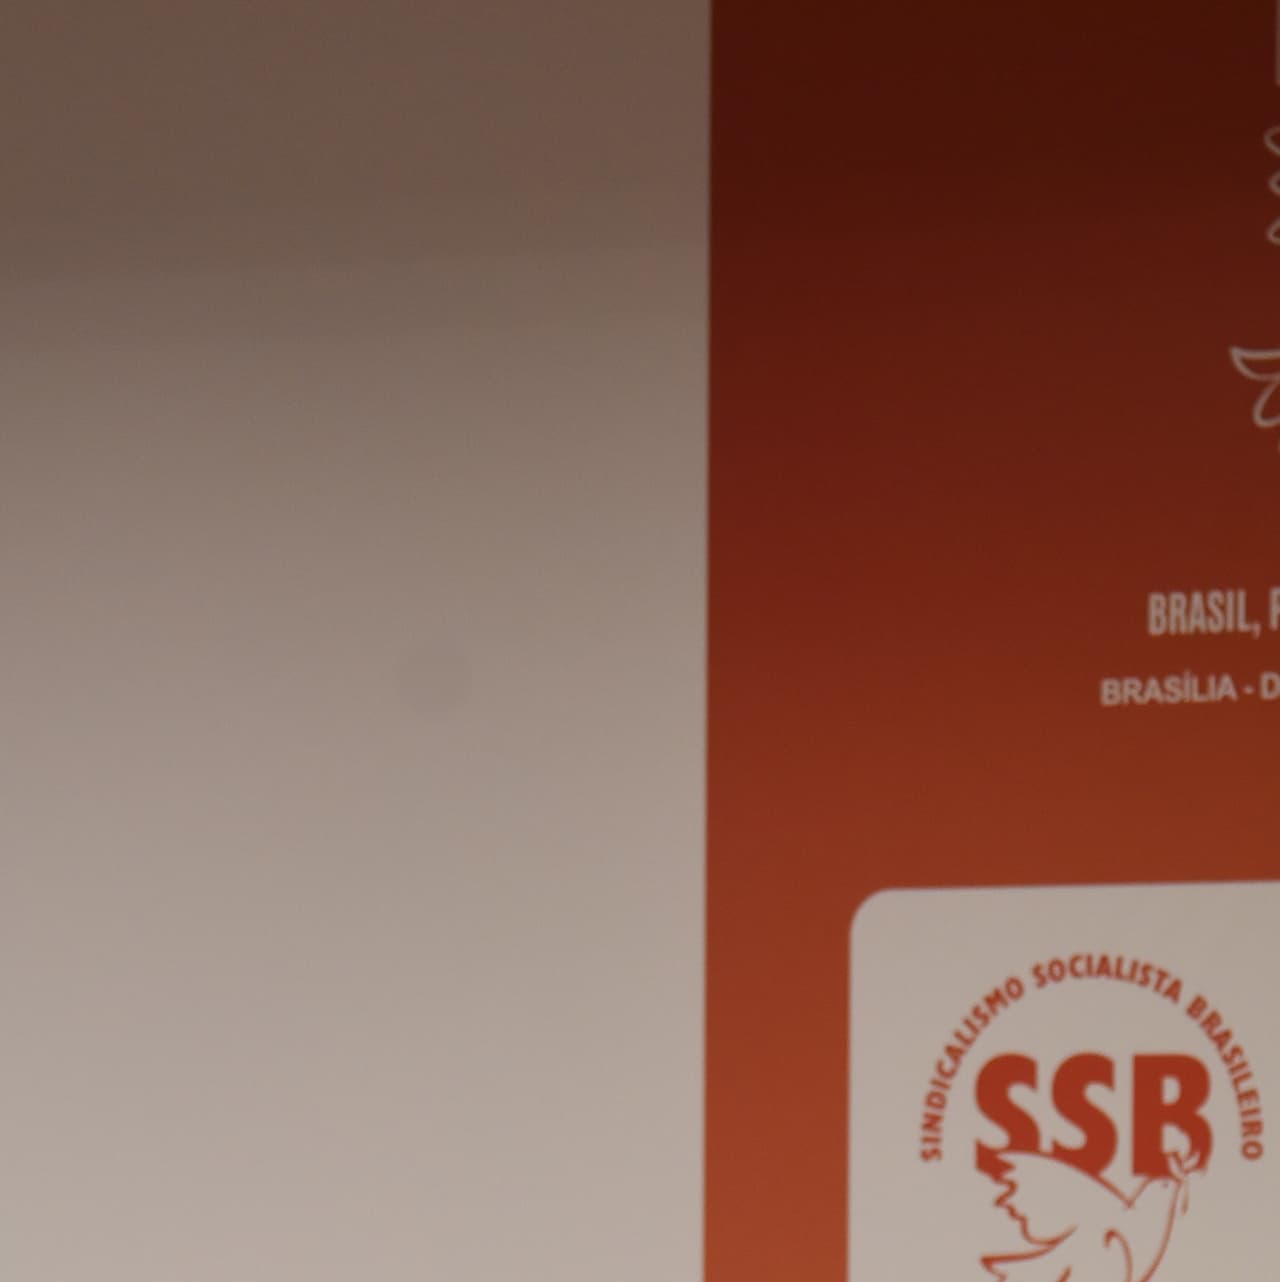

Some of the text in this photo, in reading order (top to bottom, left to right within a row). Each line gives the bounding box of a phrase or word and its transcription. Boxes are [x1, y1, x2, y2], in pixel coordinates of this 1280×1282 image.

[1148, 590, 1261, 639] BRASIL,
[1100, 669, 1238, 707] BRASÍLIA
[920, 953, 1264, 1162] SINDICALISMO SOCIALISTA BRASILEIRO
[975, 1052, 1214, 1183] SSB
